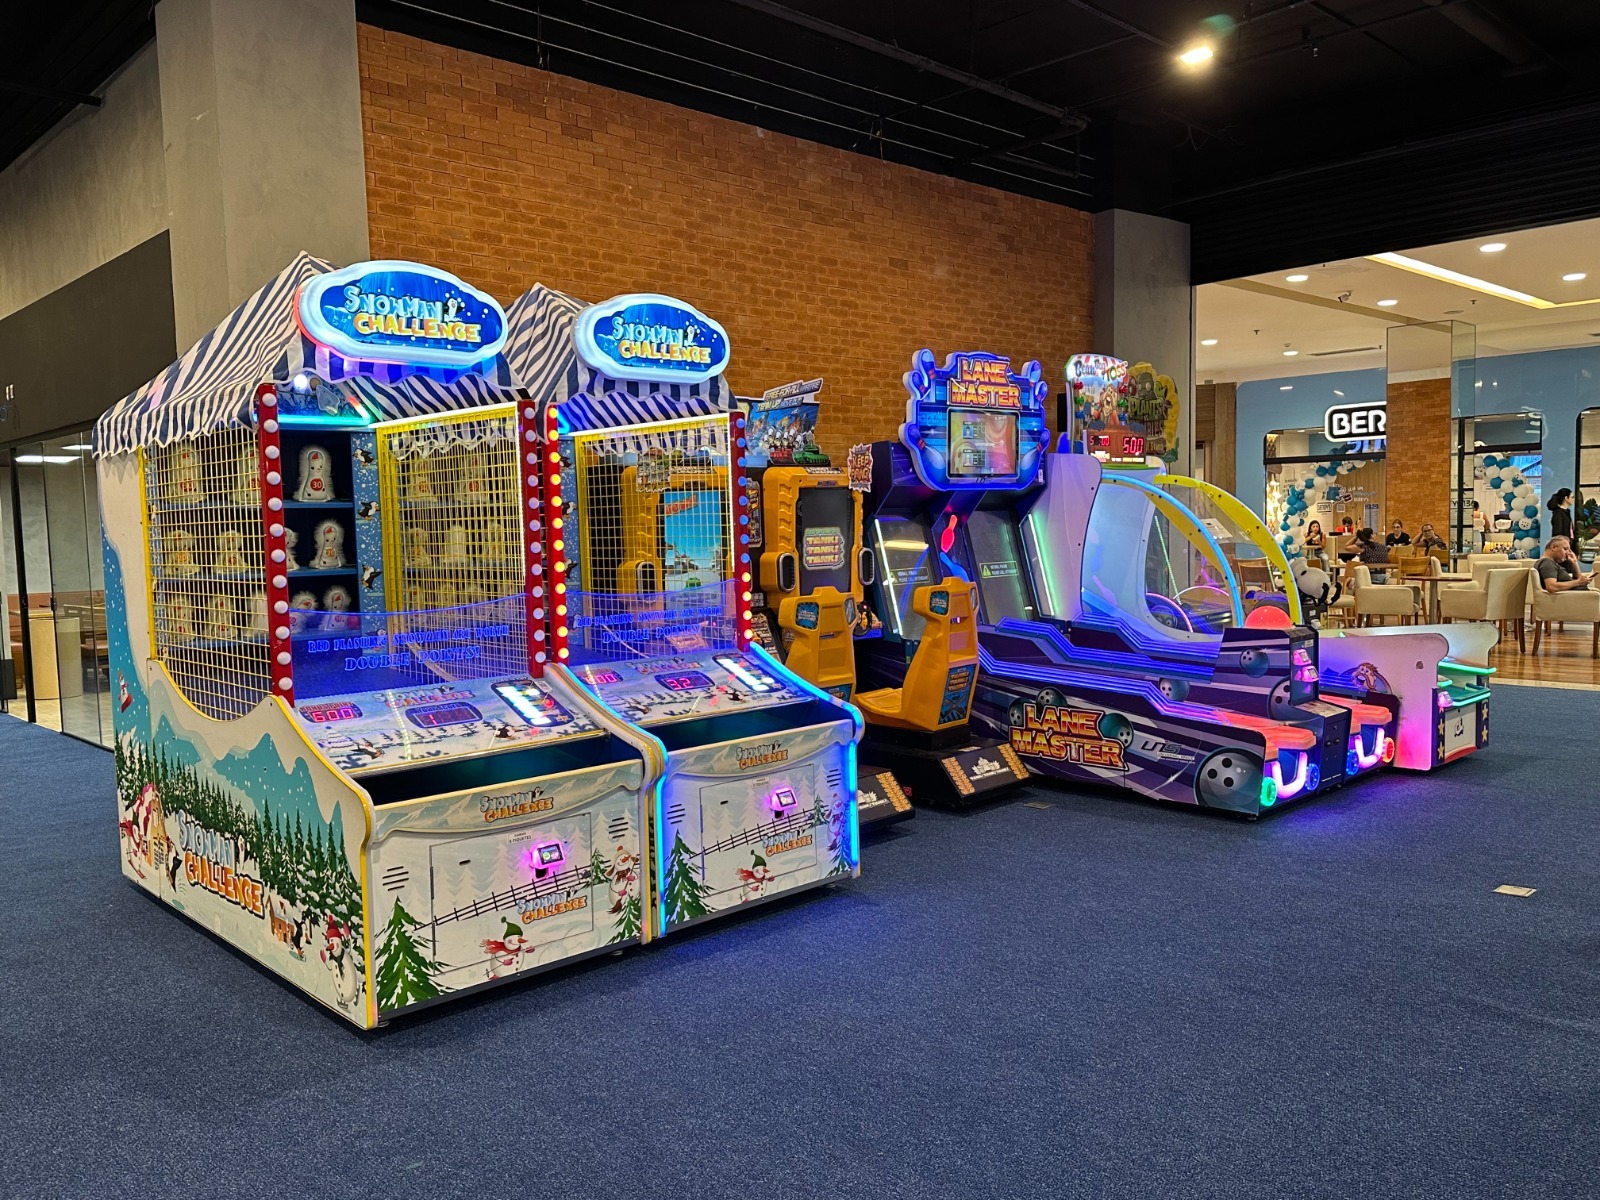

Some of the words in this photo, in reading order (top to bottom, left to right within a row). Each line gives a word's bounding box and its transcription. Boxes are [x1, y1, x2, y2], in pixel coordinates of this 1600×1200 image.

[343, 285, 442, 322] SNOWMAN
[353, 313, 481, 342] CHALLENGE
[612, 316, 684, 345] SNOWMAN
[619, 340, 711, 364] CHALLENGE
[962, 358, 1008, 384] LANE
[951, 382, 1021, 407] MASTER
[1123, 436, 1145, 454] 500
[312, 481, 323, 489] 30
[308, 640, 330, 653] RED
[333, 635, 387, 651] FLASHING
[393, 630, 449, 645] SNOWMEN
[452, 628, 470, 640] ARE
[475, 625, 510, 638] WORTH
[603, 628, 650, 643] DOUBLE
[345, 652, 410, 671] DOUBLE
[418, 646, 480, 663] POINTS!
[667, 678, 693, 690] 32
[312, 708, 354, 722] 600
[1026, 705, 1100, 736] LANE
[738, 749, 788, 770] CHALLENGE
[1012, 729, 1124, 768] MASTER
[480, 791, 533, 813] SNOWMAN
[484, 797, 554, 823] CHALLENGE
[177, 809, 236, 869] SNOWMAN
[765, 835, 812, 857] CHALLENGE
[184, 851, 265, 918] CHALLENGE
[516, 891, 567, 915] SNOWMAN
[521, 895, 588, 924] CHALLENGE
